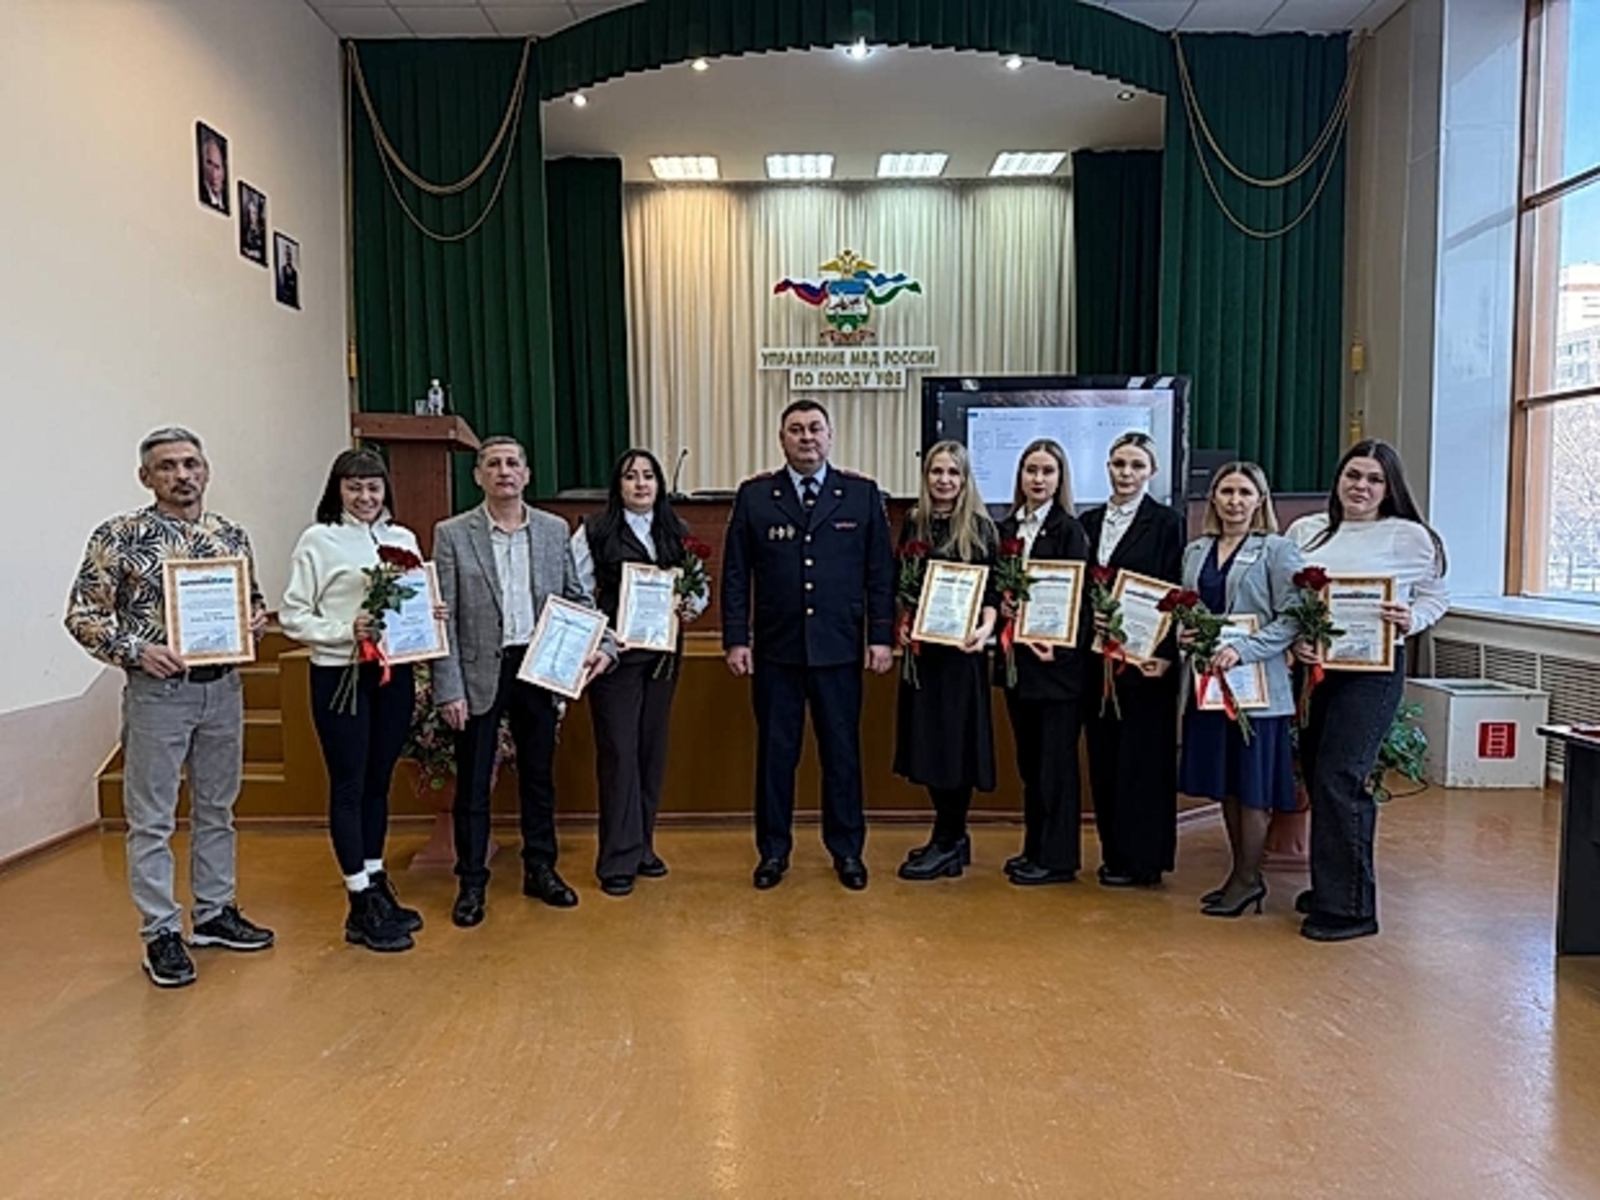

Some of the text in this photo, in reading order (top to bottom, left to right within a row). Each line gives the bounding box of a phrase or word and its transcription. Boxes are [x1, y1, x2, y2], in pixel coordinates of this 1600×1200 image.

[761, 350, 936, 367] УПРАВЛЕНИЕ МВД РОССИИ
[794, 371, 902, 387] ПО ГОРОДУ УФЕ
